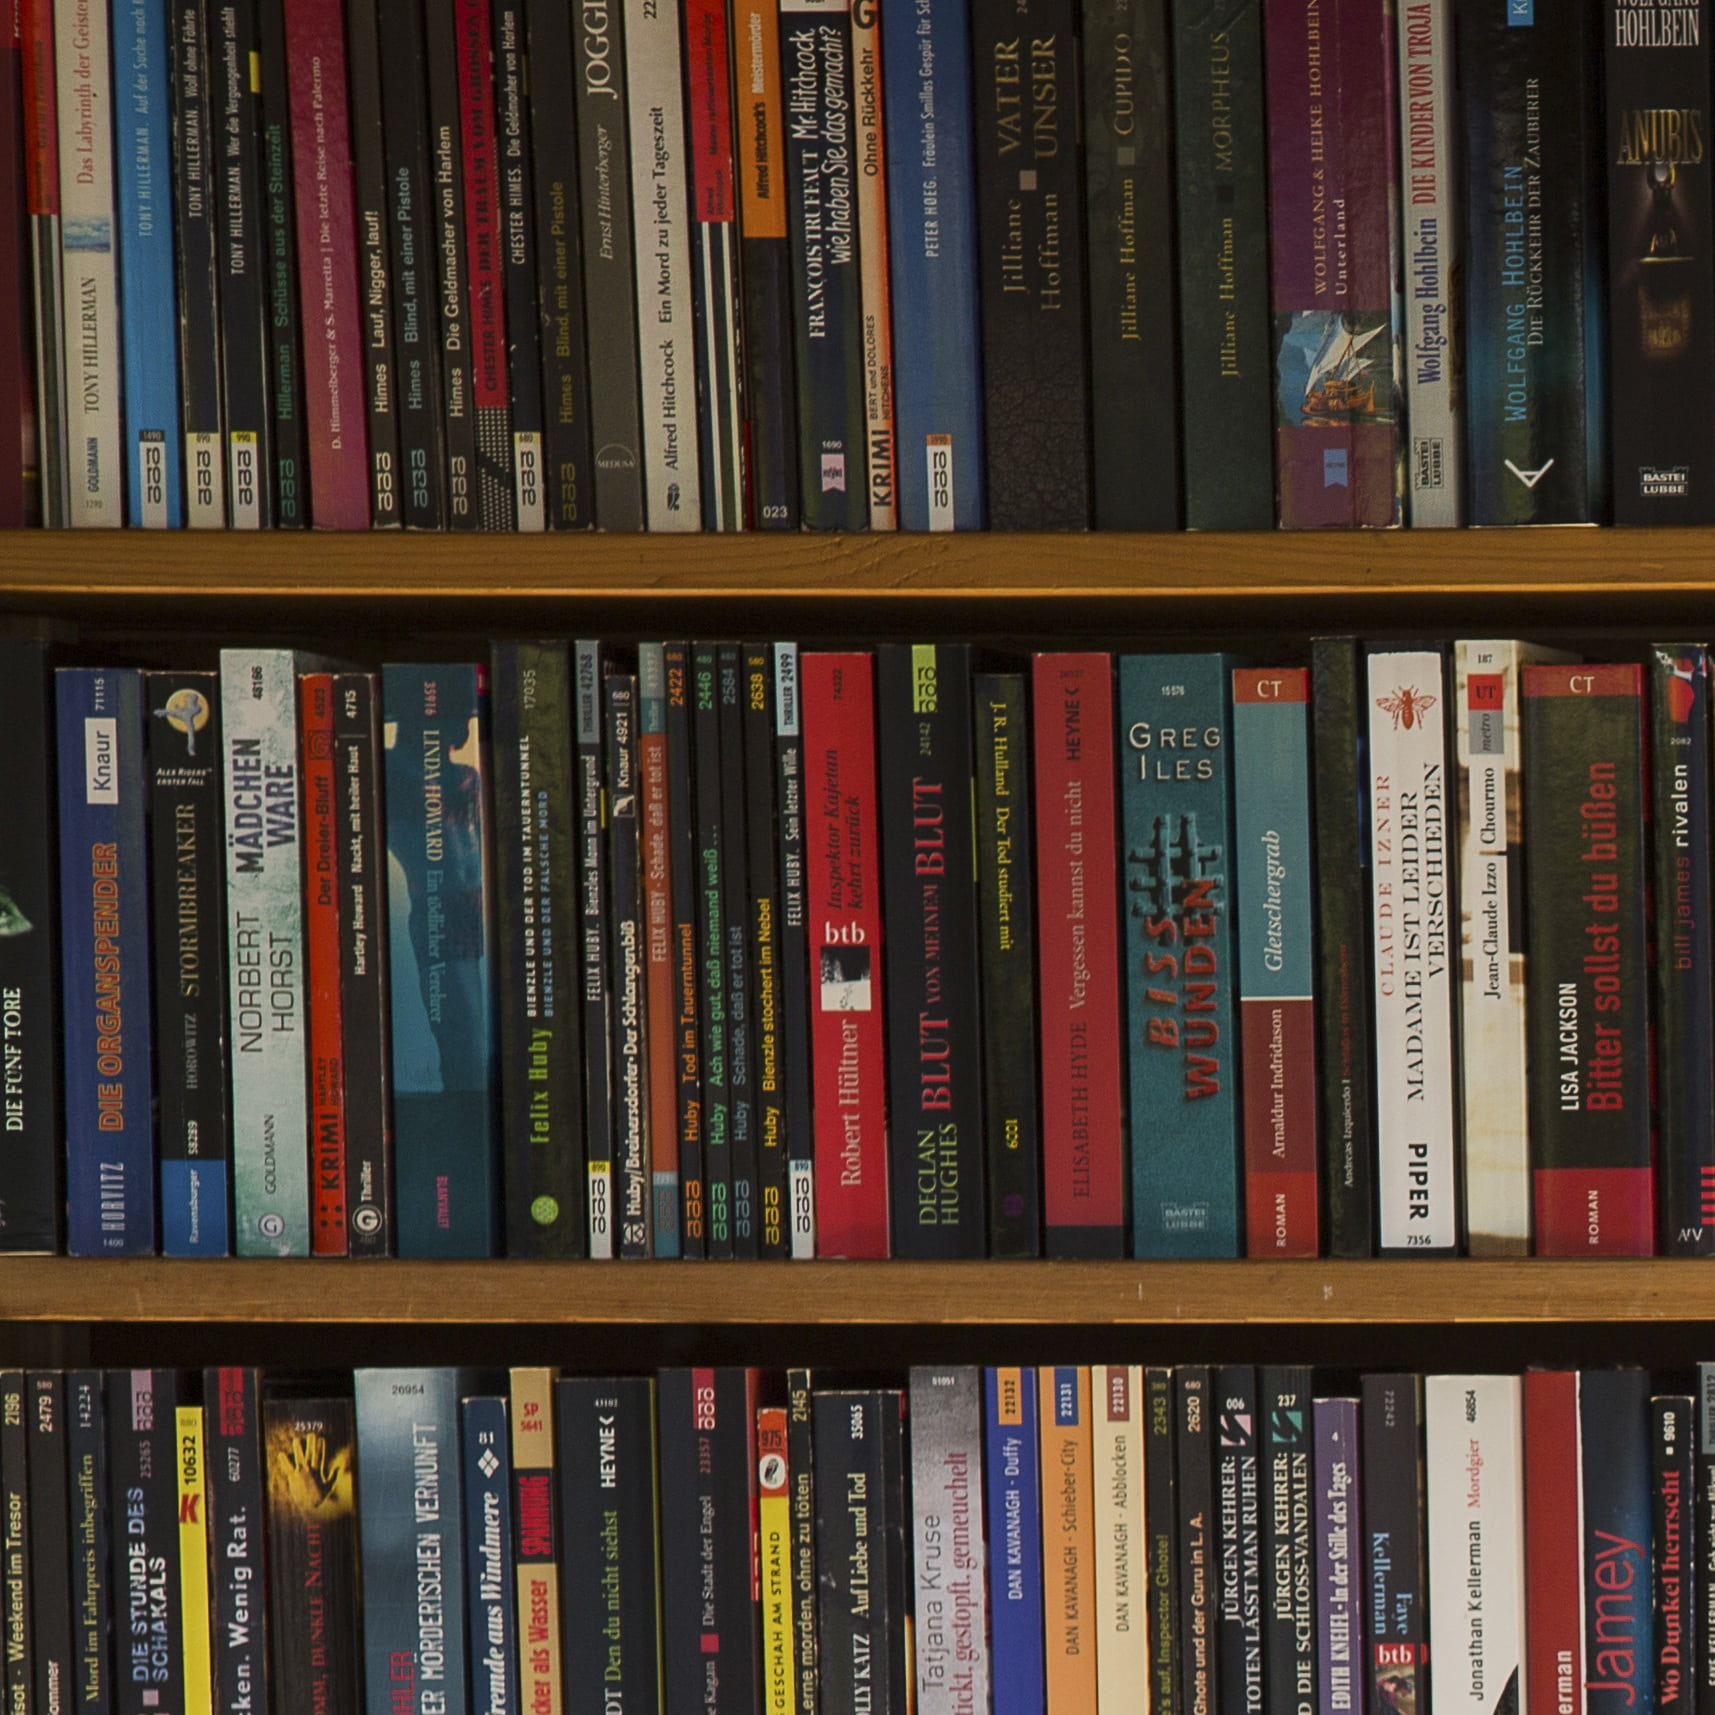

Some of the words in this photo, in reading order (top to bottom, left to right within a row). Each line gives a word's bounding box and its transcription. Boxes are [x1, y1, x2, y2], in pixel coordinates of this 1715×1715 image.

[1615, 16, 1699, 47] HOHLBEIN
[996, 38, 1021, 156] VATER
[1032, 36, 1056, 158] UNSER
[1112, 33, 1132, 136] CUPIDO
[1617, 109, 1702, 164] ANUBIS
[82, 277, 99, 367] HILLERMAN
[84, 366, 99, 414] TONY
[874, 429, 891, 506] KRIMI
[1258, 680, 1282, 698] CT
[94, 727, 116, 791] Knaur
[234, 738, 263, 873] MÄDCHEN
[264, 763, 293, 846] WARE
[179, 804, 200, 997] STORMBREAKER
[824, 922, 863, 943] btb
[1265, 831, 1282, 971] Gletschergrab
[91, 843, 121, 1076] ORGANSPENDER
[240, 913, 264, 1054] NORBERT
[271, 933, 294, 1032] HORST
[1146, 916, 1177, 1048] BISS
[1180, 879, 1221, 1101] WUNDEN
[97, 1082, 124, 1131] DIE
[1408, 1144, 1428, 1219] PIPER
[1406, 1235, 1431, 1245] 7356
[600, 1427, 615, 1488] HEYNE
[921, 1515, 944, 1591] Kruse
[922, 1604, 948, 1693] Tatjana
[1378, 1646, 1413, 1664] btb
[1584, 1528, 1645, 1706] Jamey
